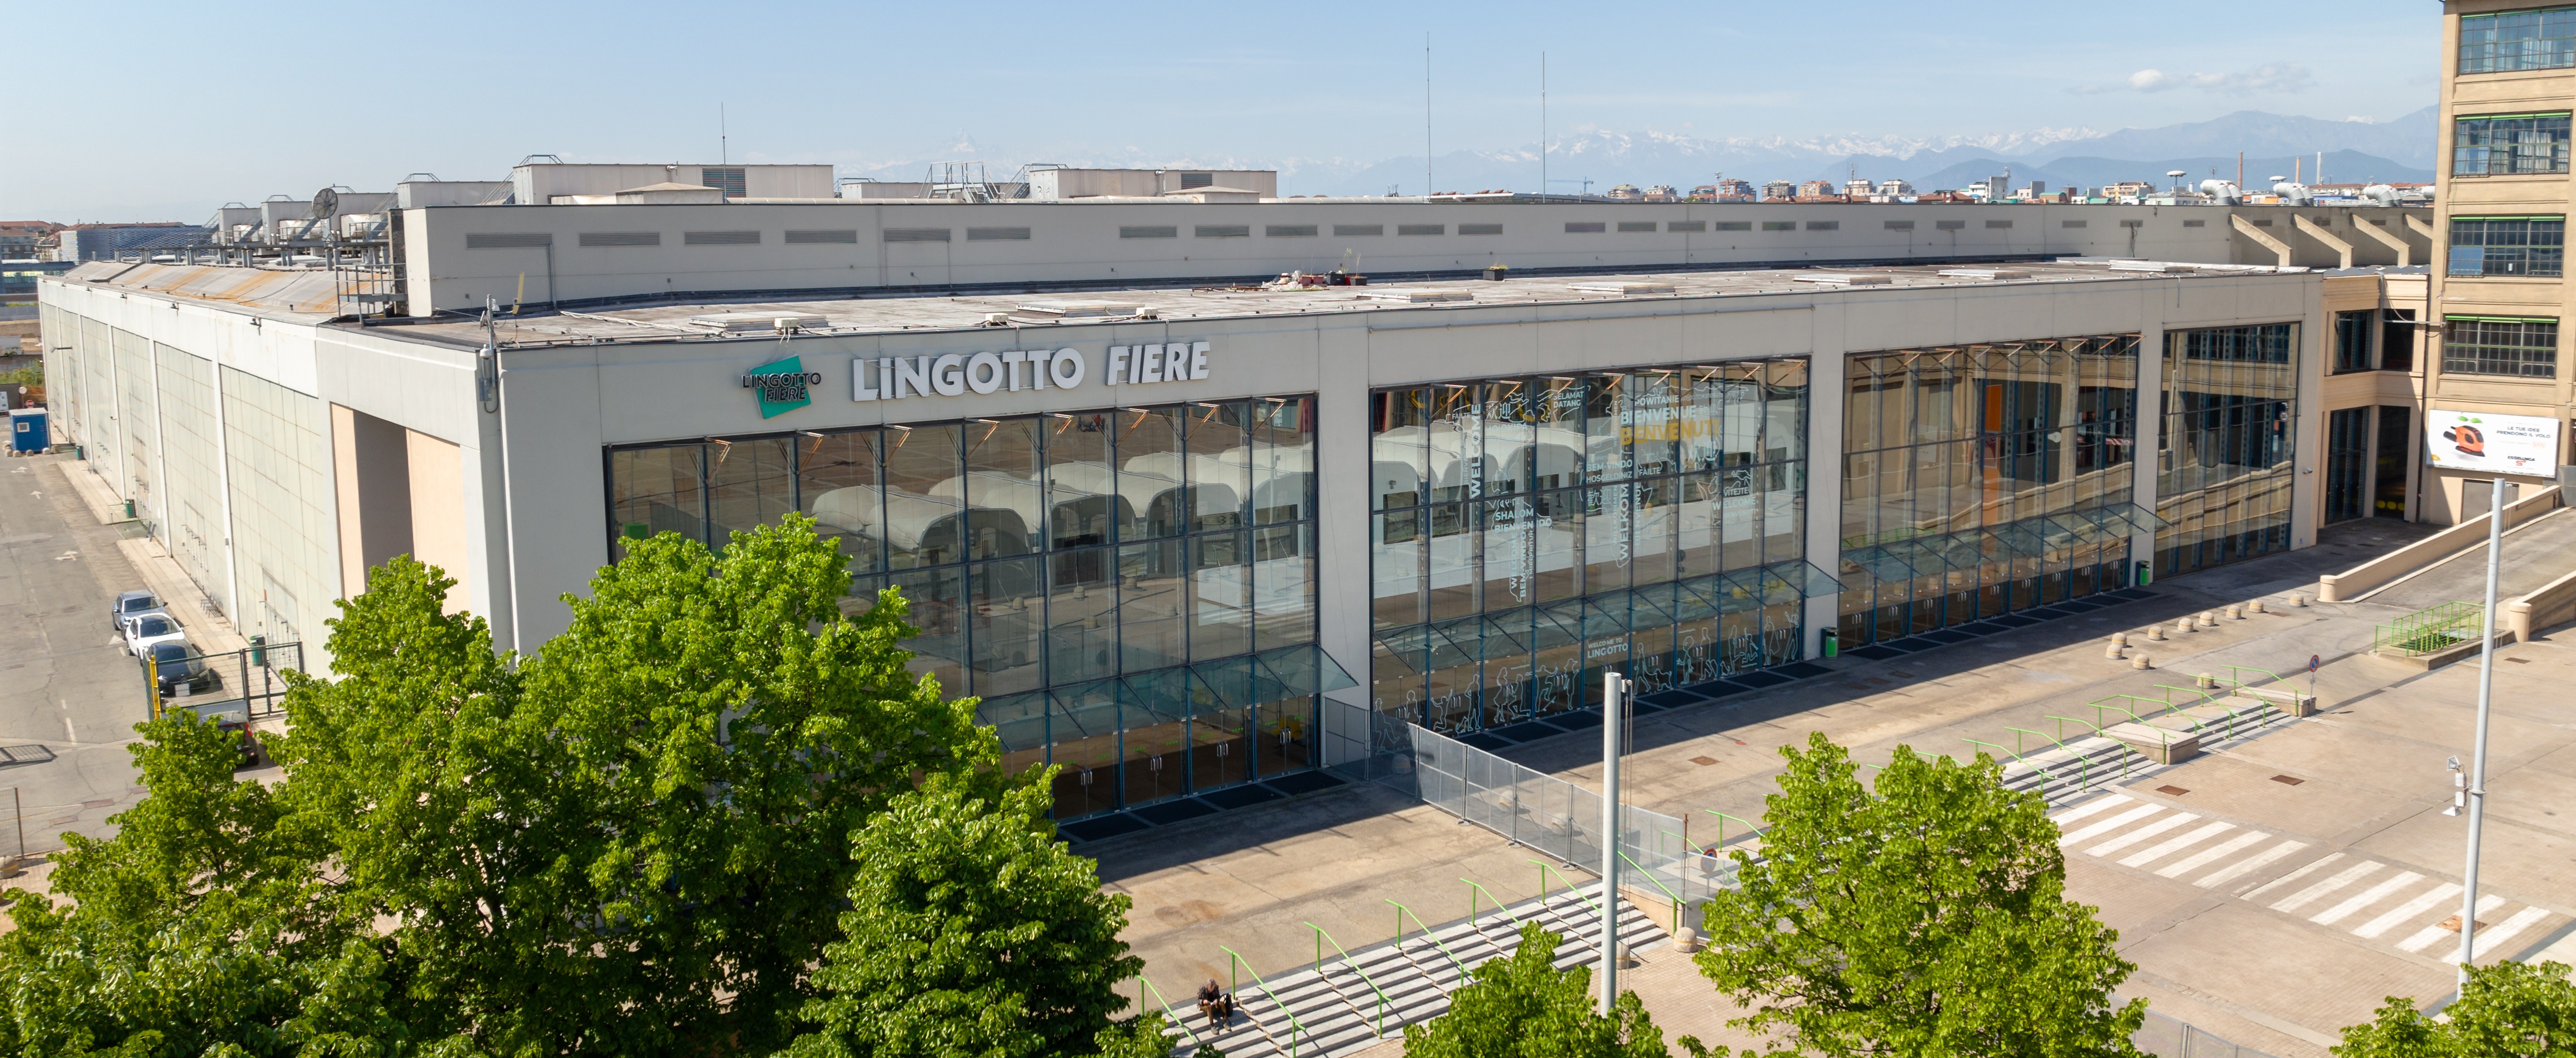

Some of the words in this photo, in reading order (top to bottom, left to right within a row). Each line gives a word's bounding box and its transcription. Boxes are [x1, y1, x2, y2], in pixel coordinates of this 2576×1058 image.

[853, 347, 1085, 402] LINGOTTO
[1105, 341, 1210, 386] FIERE
[742, 372, 821, 389] LINGOTTO
[765, 387, 807, 402] FIERE
[1554, 391, 1584, 400] SELAMAT
[1634, 395, 1679, 406] POWITANIE
[1485, 402, 1511, 420] 欢迎
[1554, 399, 1581, 408] DATANG
[1621, 405, 1697, 425] BIENVENUE
[1620, 419, 1719, 446] BENVENUTI
[1471, 404, 1481, 499] WELCOME
[1586, 459, 1632, 472] BEM-VINDO
[1639, 467, 1661, 476] FÁILTE
[1712, 496, 1756, 510] WELCOME
[1495, 508, 1534, 521] SHALOM
[1620, 483, 1629, 561] WELKOM
[1588, 643, 1628, 658] LINGOTTO
